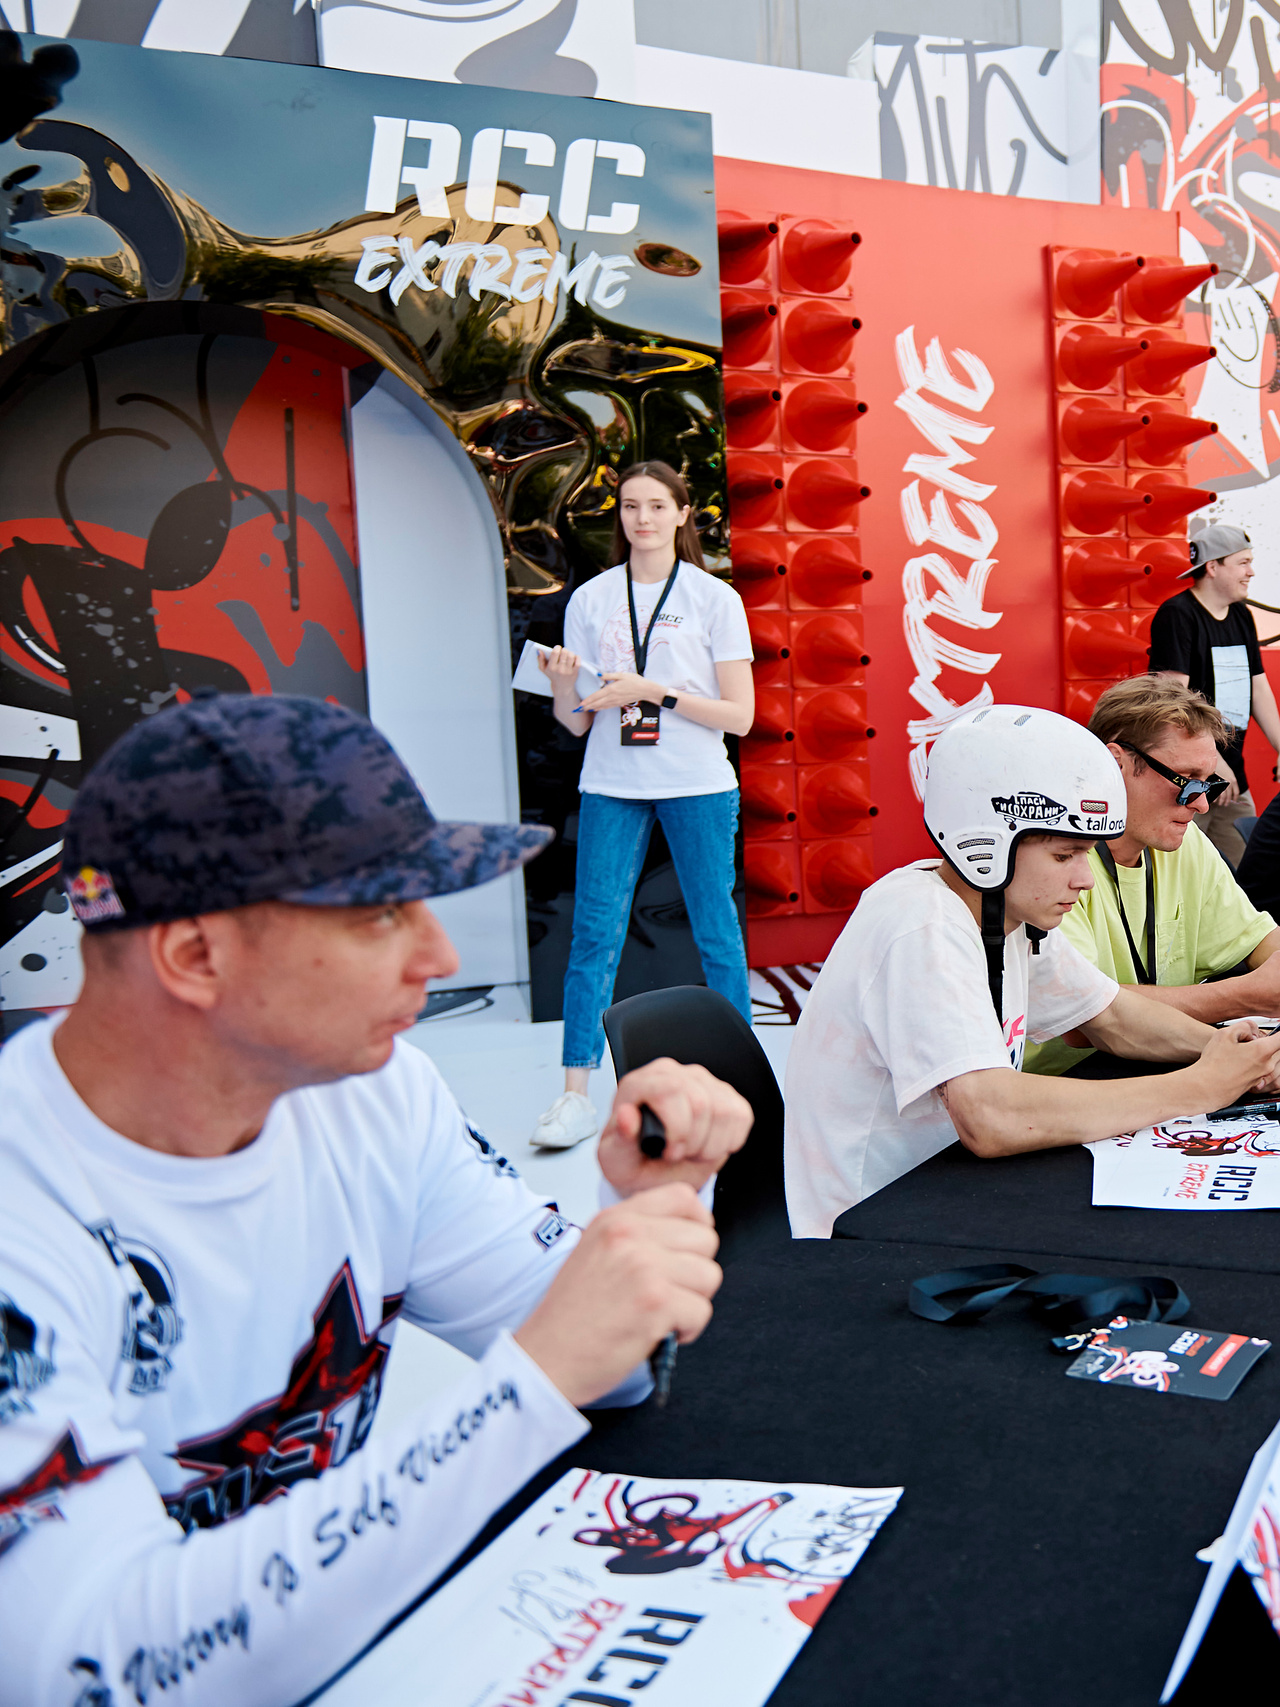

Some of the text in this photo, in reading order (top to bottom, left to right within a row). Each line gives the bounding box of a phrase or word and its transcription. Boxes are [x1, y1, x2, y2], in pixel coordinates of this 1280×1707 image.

[364, 115, 646, 235] RCC
[354, 235, 636, 309] EXTREME
[894, 325, 1003, 803] XTREME
[657, 613, 684, 624] RCC
[1086, 815, 1108, 831] tall
[1174, 1163, 1210, 1200] EXTREME
[1207, 1165, 1258, 1201] RCC
[498, 1597, 628, 1707] EXTREM
